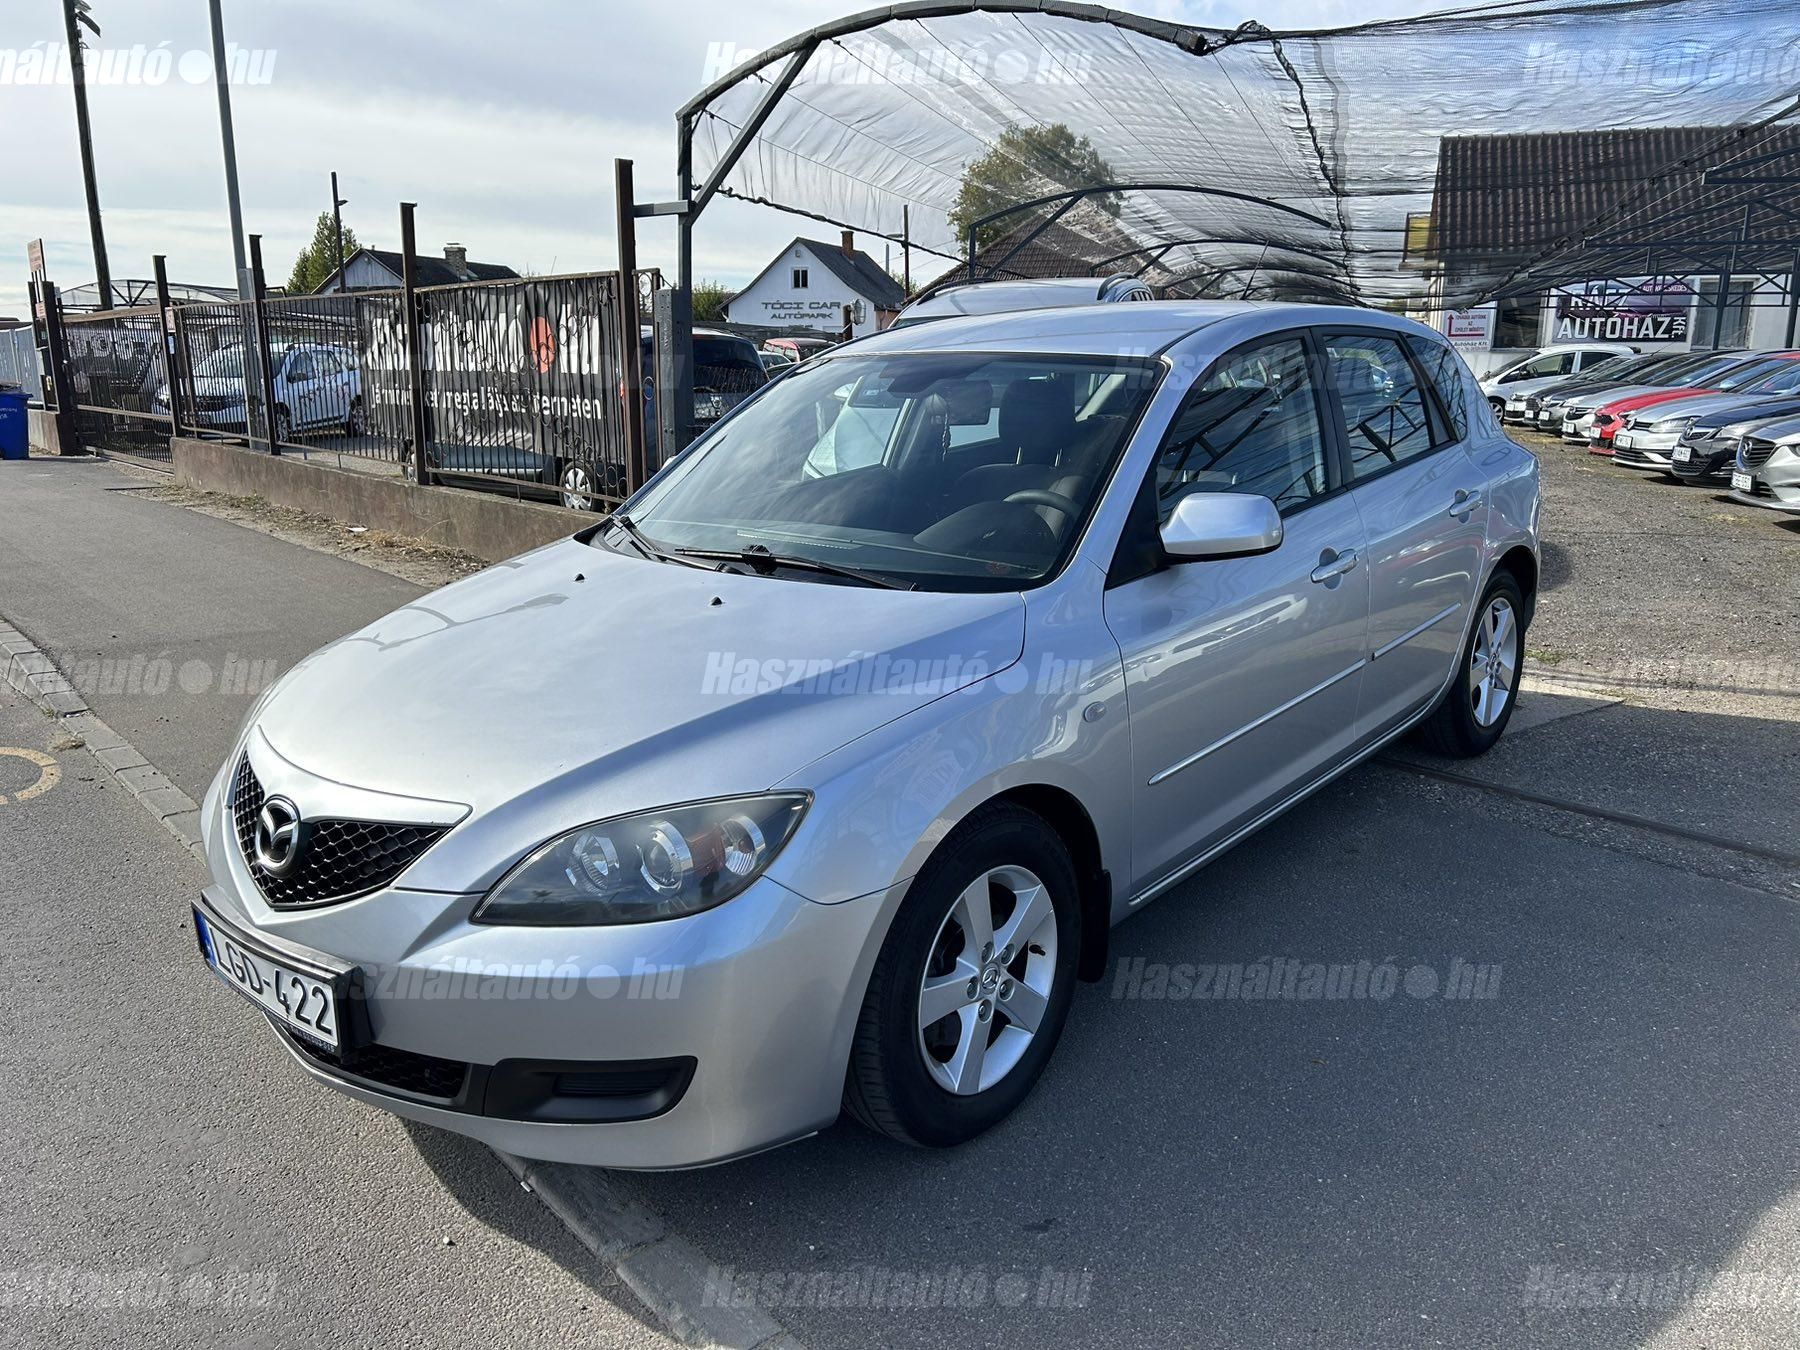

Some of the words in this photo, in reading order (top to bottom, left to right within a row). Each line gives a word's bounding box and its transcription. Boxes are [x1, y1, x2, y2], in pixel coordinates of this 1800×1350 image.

[808, 301, 840, 310] CAR
[770, 311, 833, 320] AUTÓPARK
[1557, 313, 1671, 339] AUTÓHÁZ
[210, 927, 333, 1036] LGD-422
